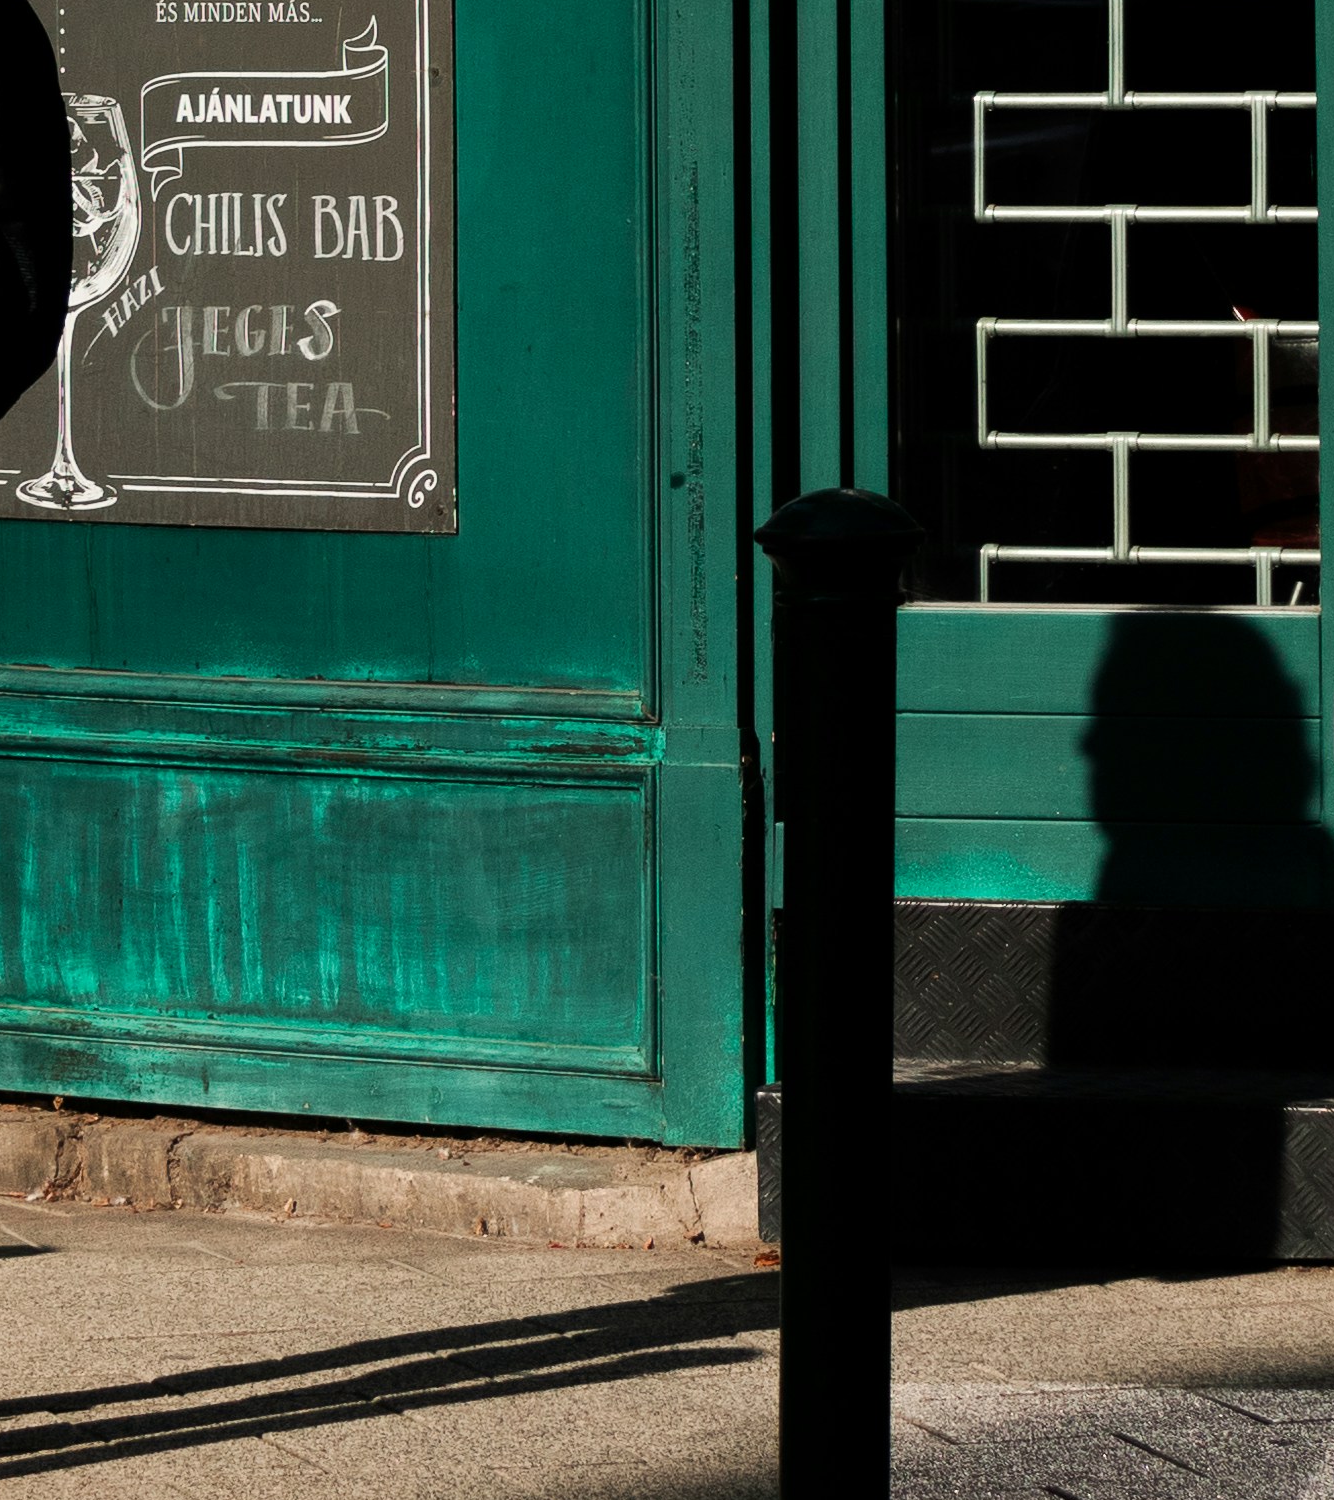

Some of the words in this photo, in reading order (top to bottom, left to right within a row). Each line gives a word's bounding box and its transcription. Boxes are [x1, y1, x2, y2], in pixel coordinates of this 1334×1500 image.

[183, 1, 263, 24] MINDEN
[175, 87, 353, 124] AJÁNLATUNK
[165, 192, 288, 258] CHILIS
[310, 194, 405, 262] BAB
[81, 266, 165, 364] HÁZI
[130, 299, 342, 411] JEGES
[213, 380, 392, 436] TEA
